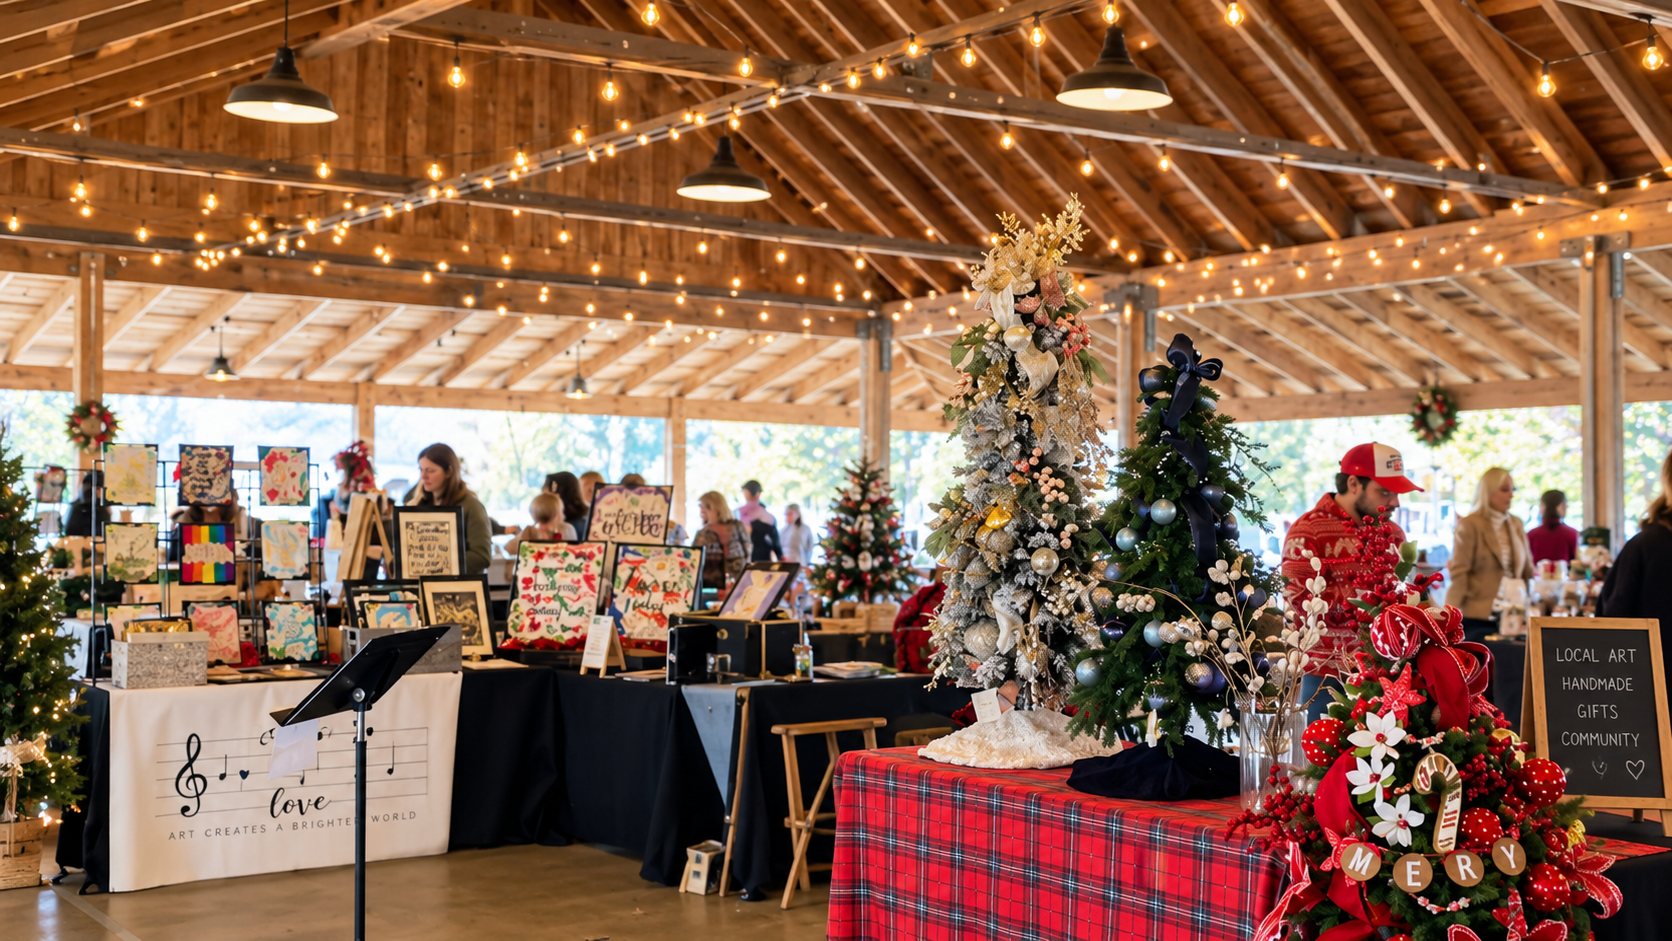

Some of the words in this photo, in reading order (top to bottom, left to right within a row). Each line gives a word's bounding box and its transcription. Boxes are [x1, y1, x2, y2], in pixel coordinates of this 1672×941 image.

[1556, 648, 1600, 662] LOCAL
[1608, 648, 1637, 663] ART
[1562, 677, 1634, 692] HANDMADE
[1577, 704, 1619, 719] GIFTS
[1561, 731, 1640, 747] COMMUNITY
[269, 787, 332, 819] love
[168, 829, 195, 840] ART
[204, 824, 266, 838] CREATES
[275, 823, 284, 832] A
[371, 811, 417, 823] WORLD
[1347, 844, 1516, 886] MERY
